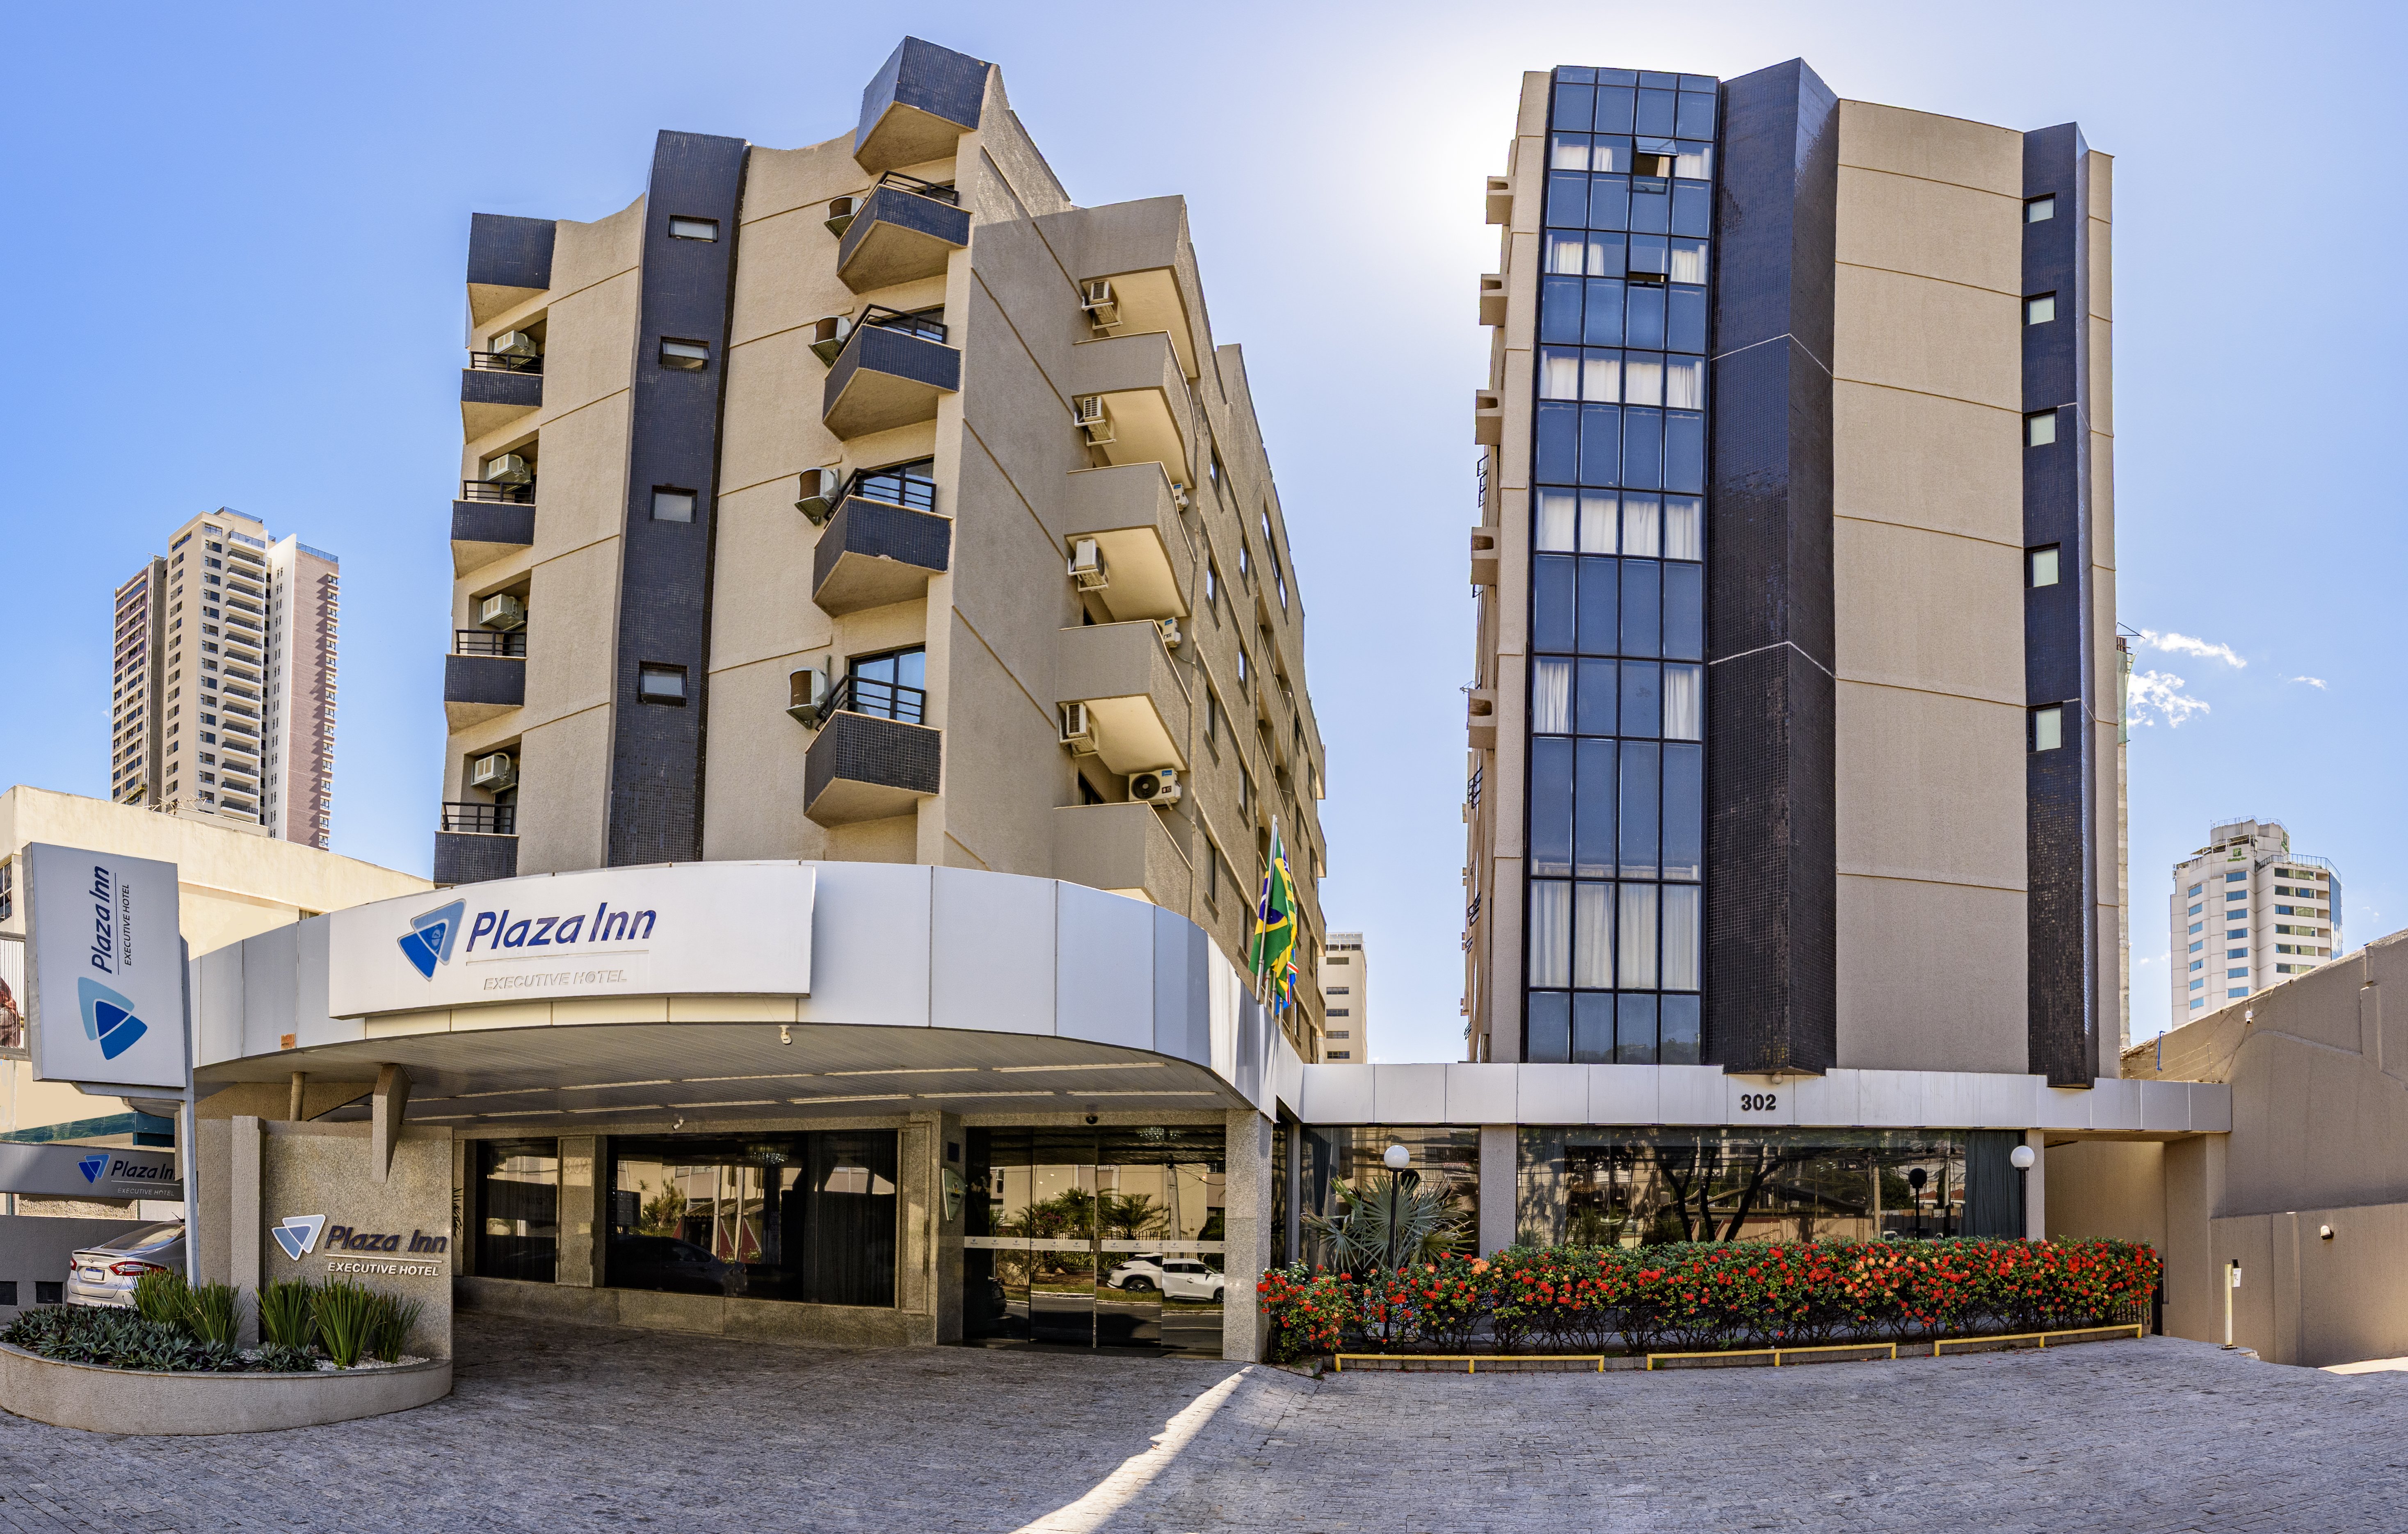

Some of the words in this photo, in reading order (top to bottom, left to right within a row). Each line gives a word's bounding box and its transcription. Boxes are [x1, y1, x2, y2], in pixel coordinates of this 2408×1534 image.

[89, 866, 110, 903] Inn
[91, 903, 112, 974] Plaza
[123, 914, 131, 966] EXECUTIVE
[466, 909, 586, 952] Plaza
[588, 902, 656, 942] Inn
[484, 972, 570, 990] EXECUTIVE
[573, 970, 627, 984] HOTEL
[1741, 1093, 1776, 1111] 302
[111, 1160, 158, 1178] Plaza
[159, 1164, 175, 1180] In
[324, 1226, 400, 1251] Plaza
[408, 1230, 447, 1253] Inn
[328, 1262, 397, 1274] EXECUTIVE
[399, 1265, 439, 1276] HOTEL
